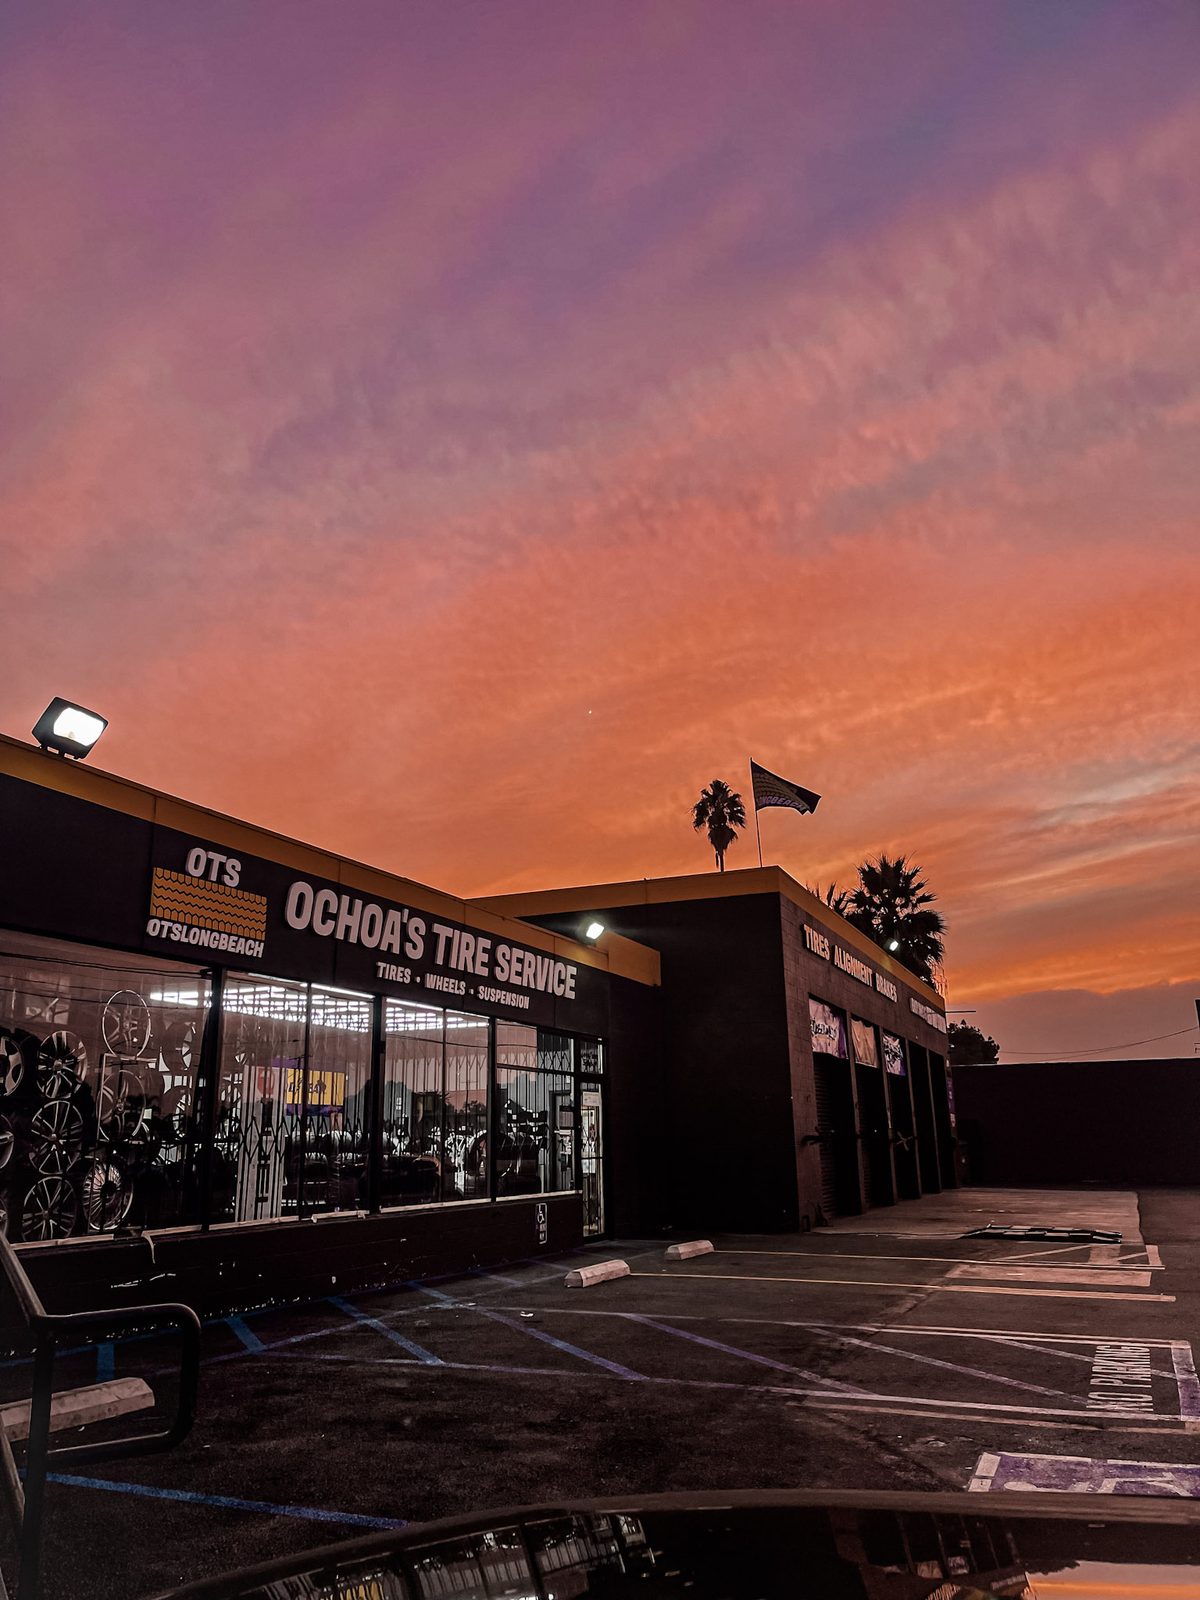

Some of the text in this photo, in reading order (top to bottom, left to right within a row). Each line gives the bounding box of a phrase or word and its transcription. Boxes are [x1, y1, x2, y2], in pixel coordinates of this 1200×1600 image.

[185, 847, 242, 888] OTS
[146, 918, 265, 958] OTSLONGBEACH
[285, 881, 577, 1000] OCHOA'S TIRE SERVICE
[803, 923, 898, 1003] TIRES ALIGNMENT BRAKES
[376, 961, 530, 1010] TIRES WHEELS SUSPENSION
[1086, 1345, 1154, 1412] NO PARKING
